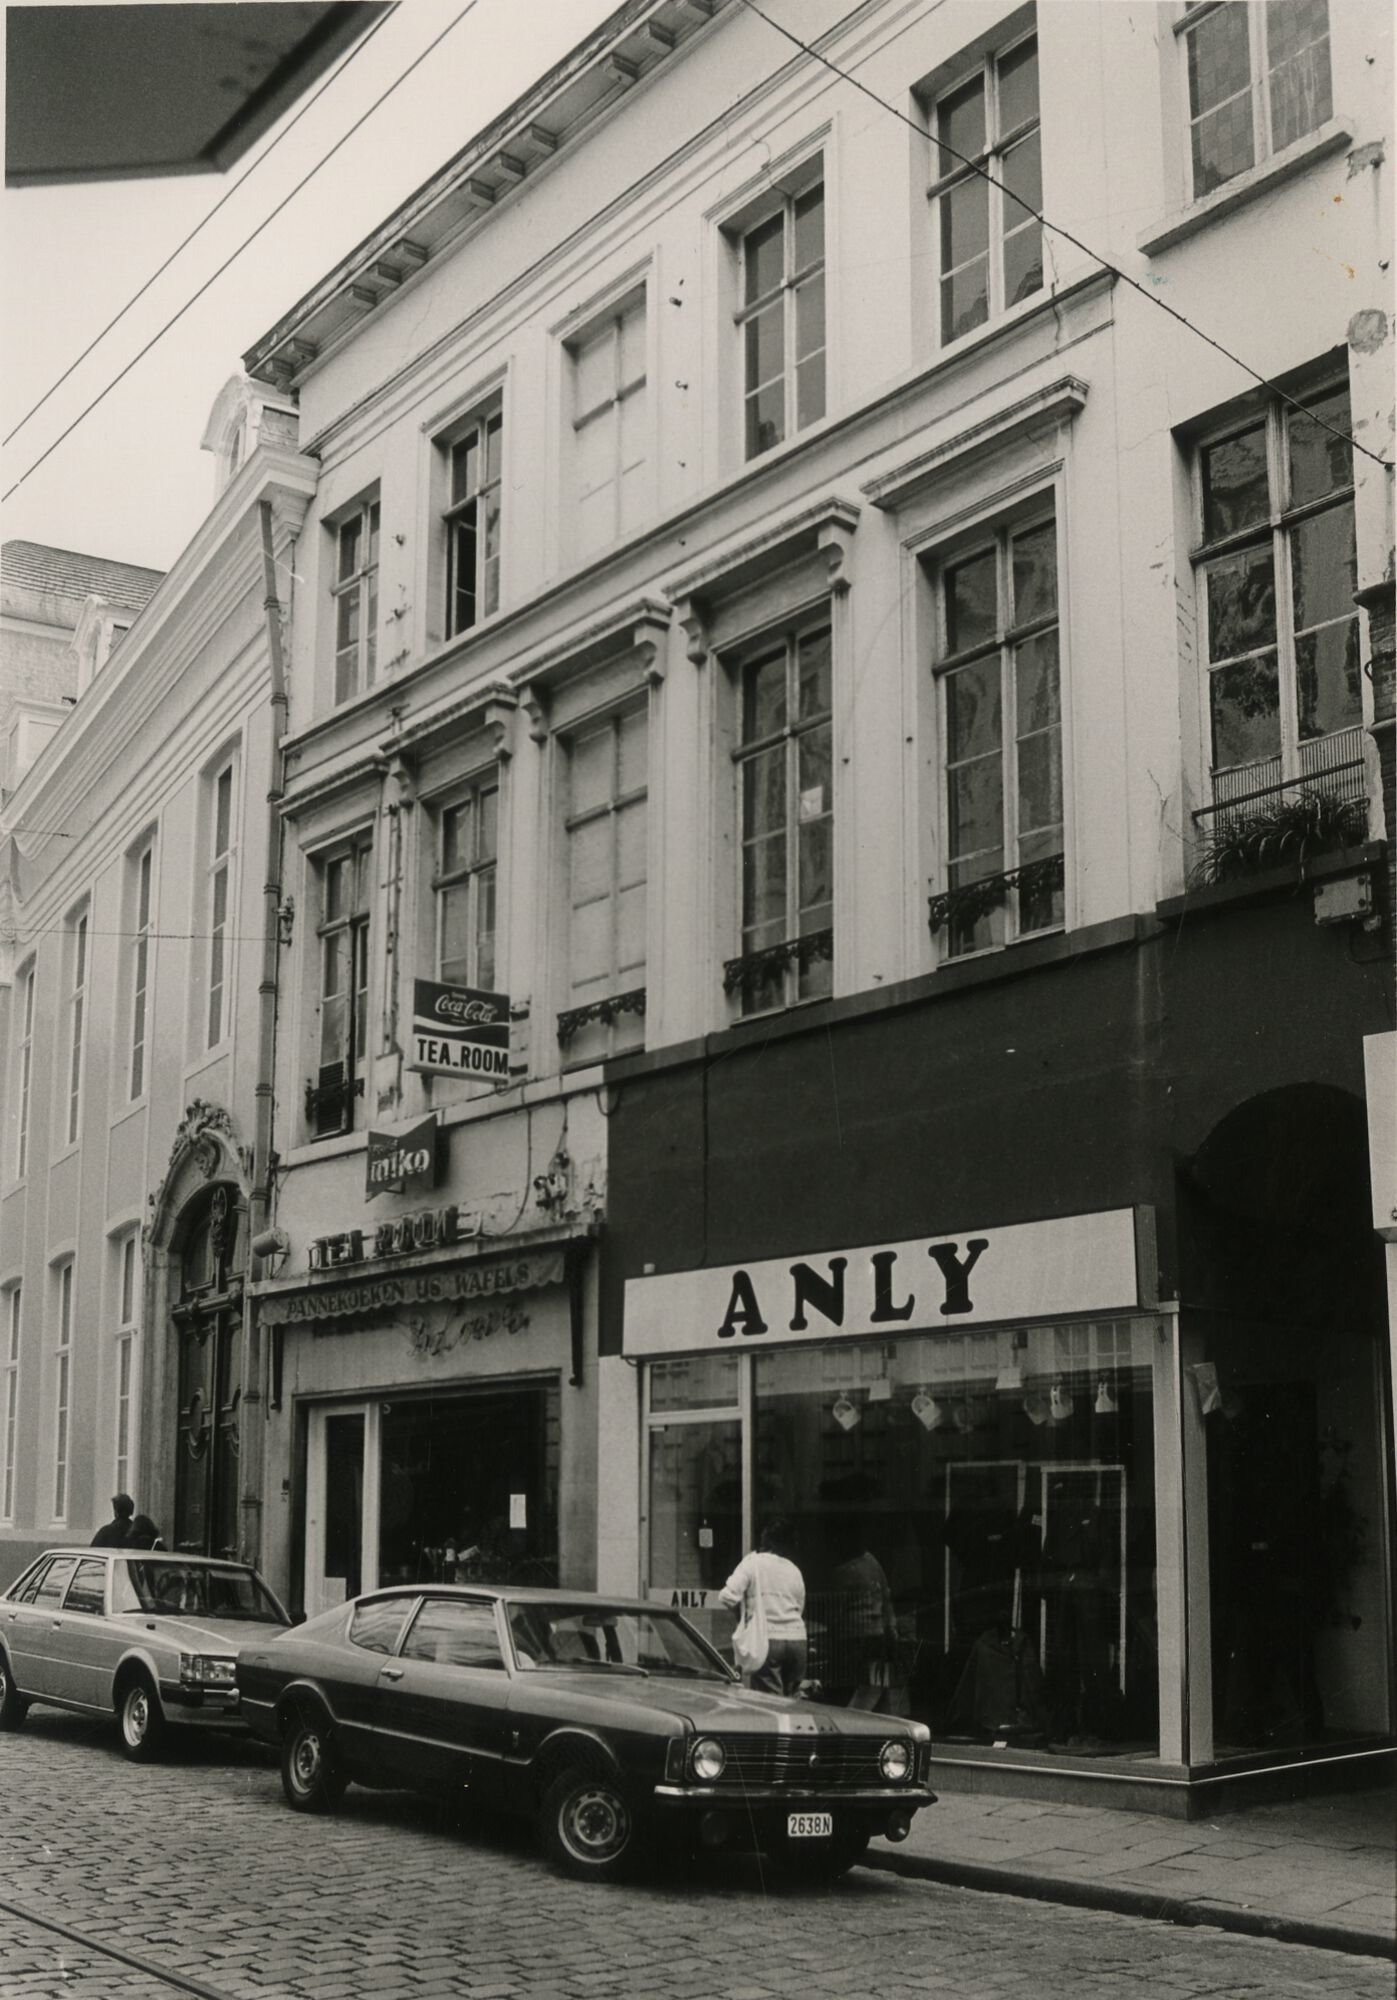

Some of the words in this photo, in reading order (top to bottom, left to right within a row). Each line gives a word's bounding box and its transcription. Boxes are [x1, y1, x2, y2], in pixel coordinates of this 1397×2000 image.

[286, 1280, 405, 1319] PANNEKOEKEN
[455, 1263, 529, 1294] WAFELS
[717, 1238, 989, 1338] ANLY
[671, 1590, 707, 1608] ANLY
